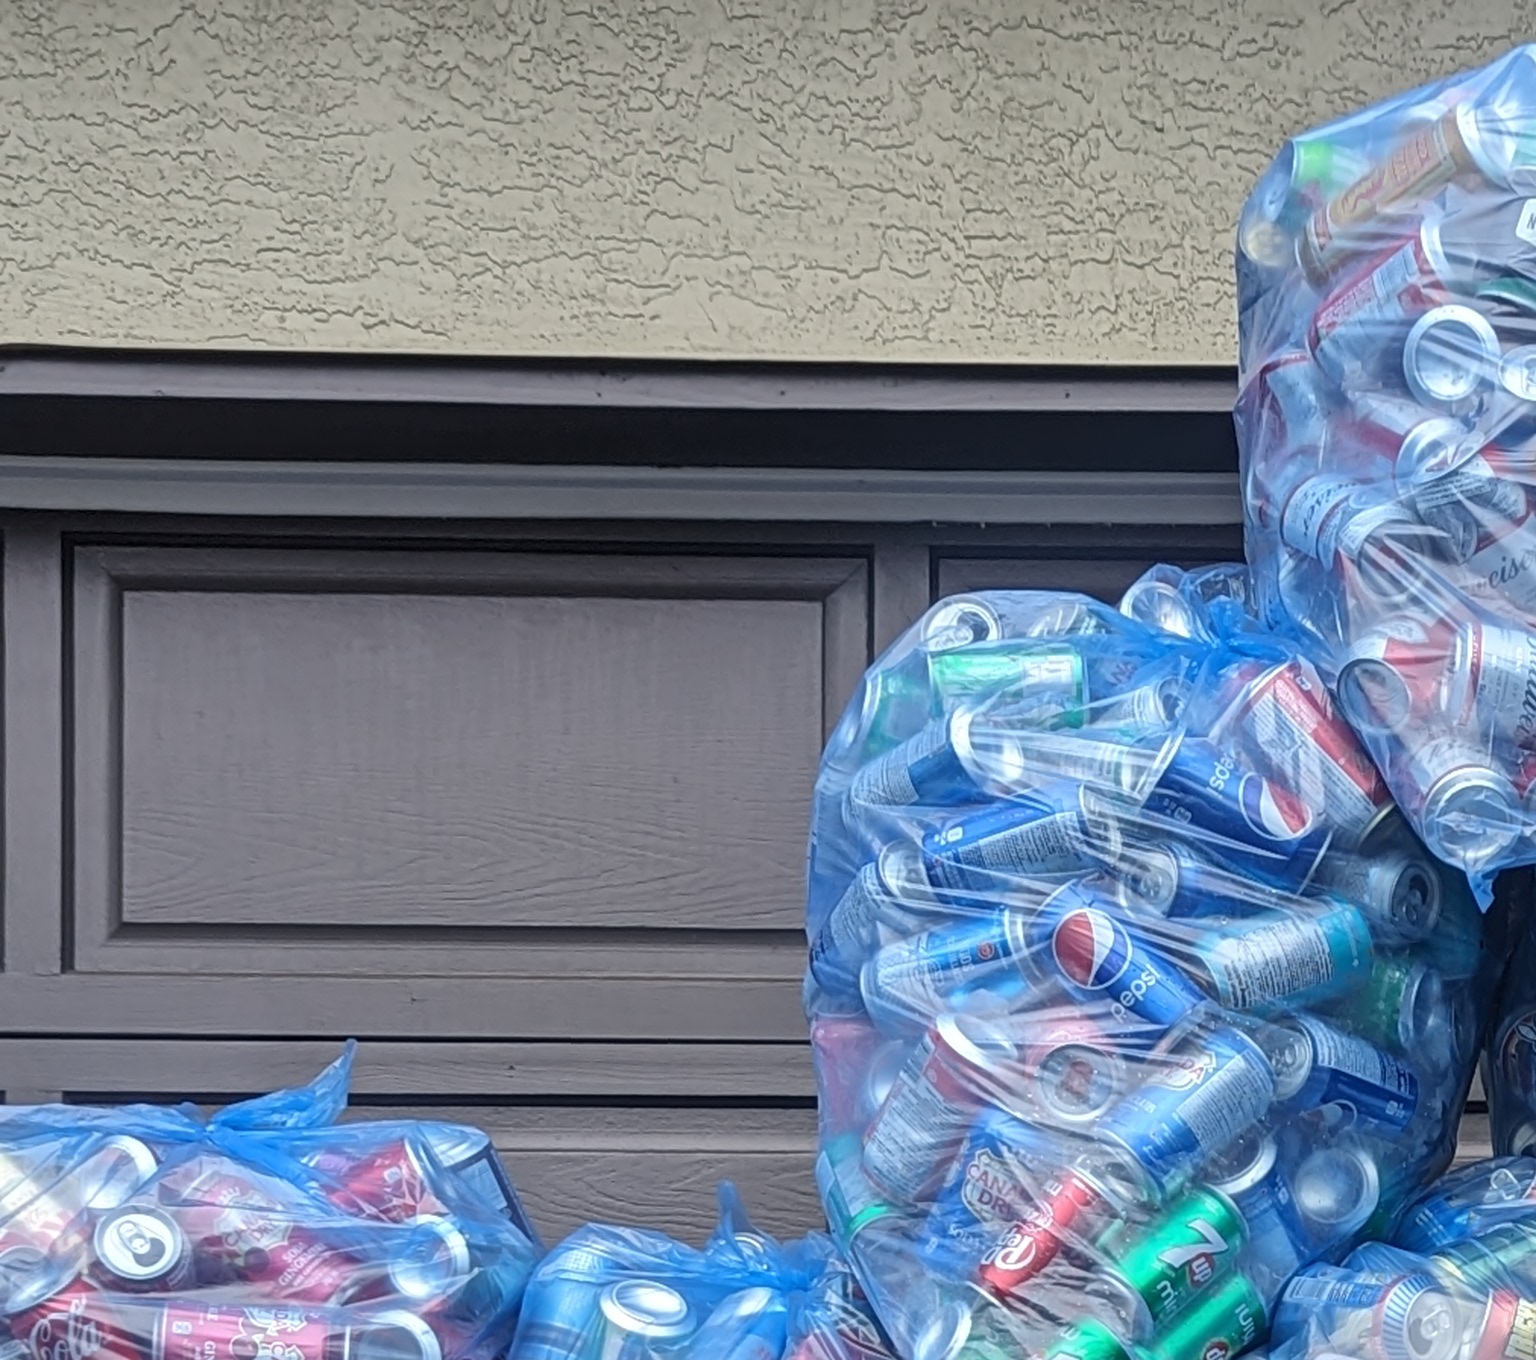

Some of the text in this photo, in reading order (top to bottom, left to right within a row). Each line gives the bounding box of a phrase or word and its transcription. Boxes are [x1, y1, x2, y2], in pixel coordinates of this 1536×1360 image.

[1109, 967, 1159, 1022] pepsi
[1158, 1219, 1228, 1285] 7 up
